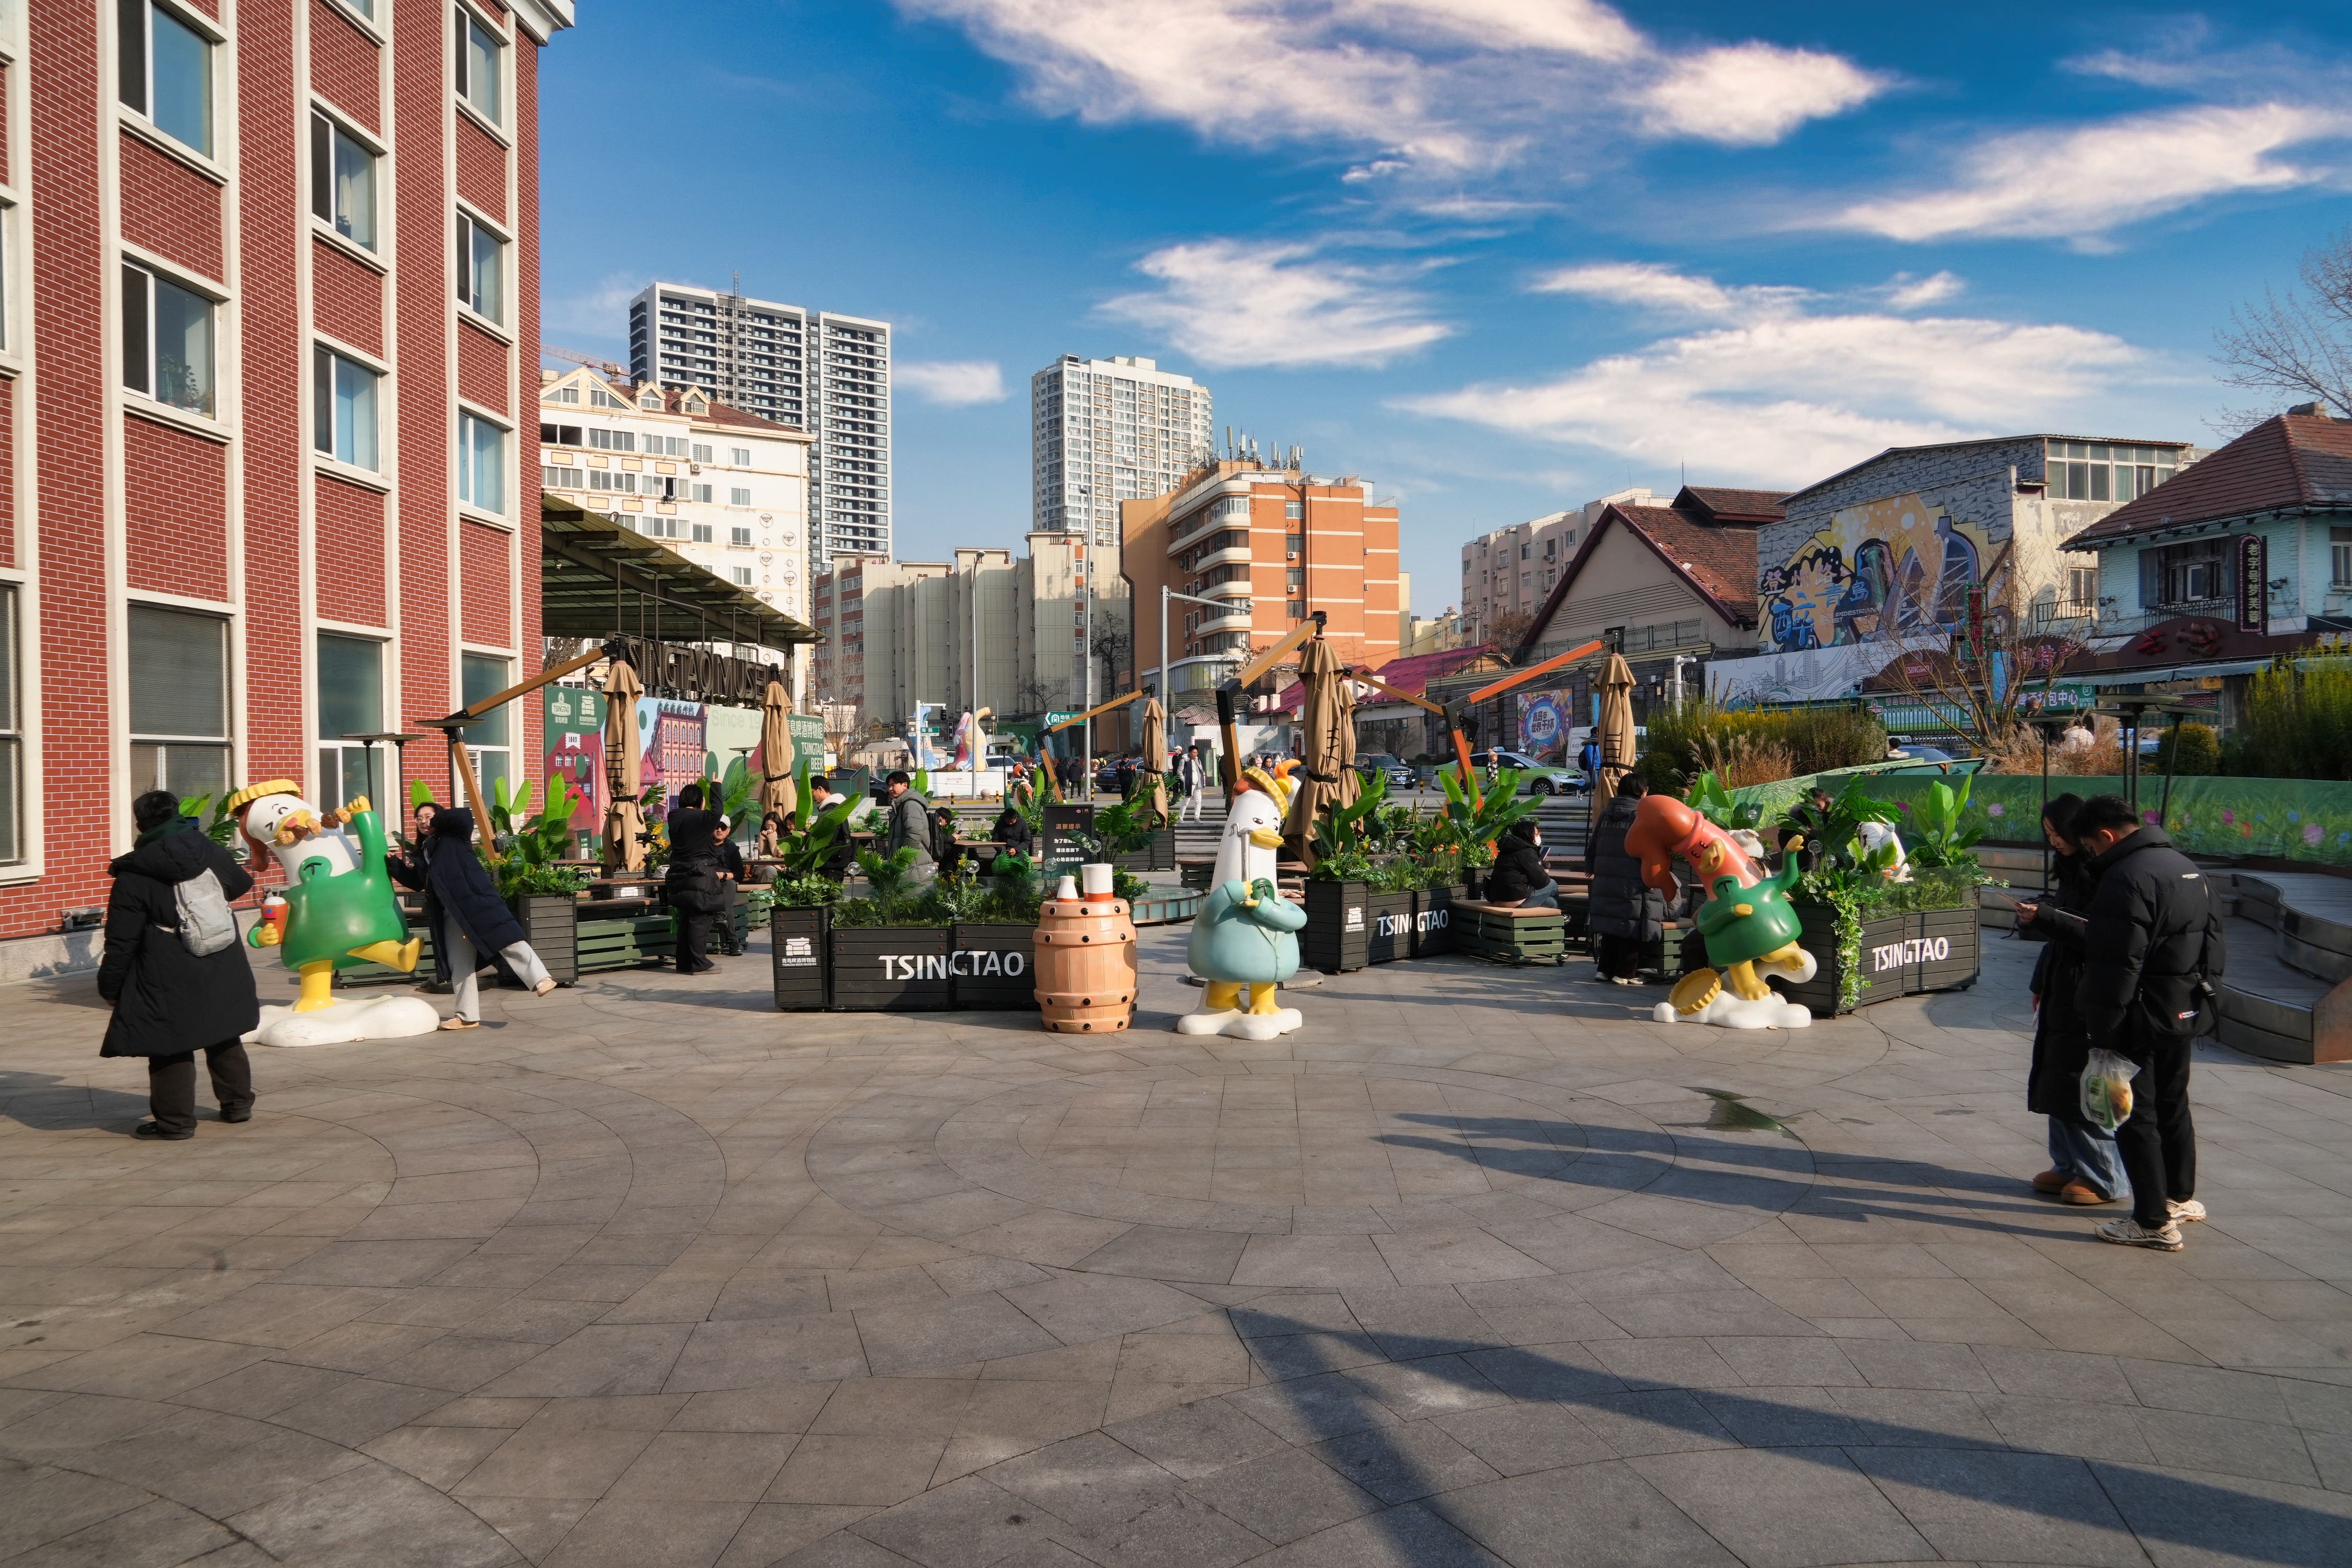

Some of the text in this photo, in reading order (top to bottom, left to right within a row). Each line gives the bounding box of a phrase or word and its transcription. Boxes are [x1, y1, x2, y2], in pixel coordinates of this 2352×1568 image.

[1762, 562, 1837, 596] 登州路
[2247, 543, 2259, 623] 老字号梦芙蓉
[1771, 591, 1816, 646] 醉
[1820, 617, 1843, 625] STREET
[1835, 607, 1877, 618] PEDESTRIAN
[715, 653, 789, 701] MUSE
[1905, 665, 1929, 674] TSINGTAO
[553, 705, 570, 713] TSINGTAO
[1533, 710, 1548, 723] 青岛与
[712, 708, 764, 730] Since 19
[1531, 718, 1555, 733] 世界干杯
[801, 742, 823, 755] TSINGTAO
[811, 757, 823, 770] BEER
[1377, 909, 1449, 937] TSINGTAO
[1872, 937, 1949, 972] TSINGTAO
[878, 950, 1024, 979] TSINGTAO
